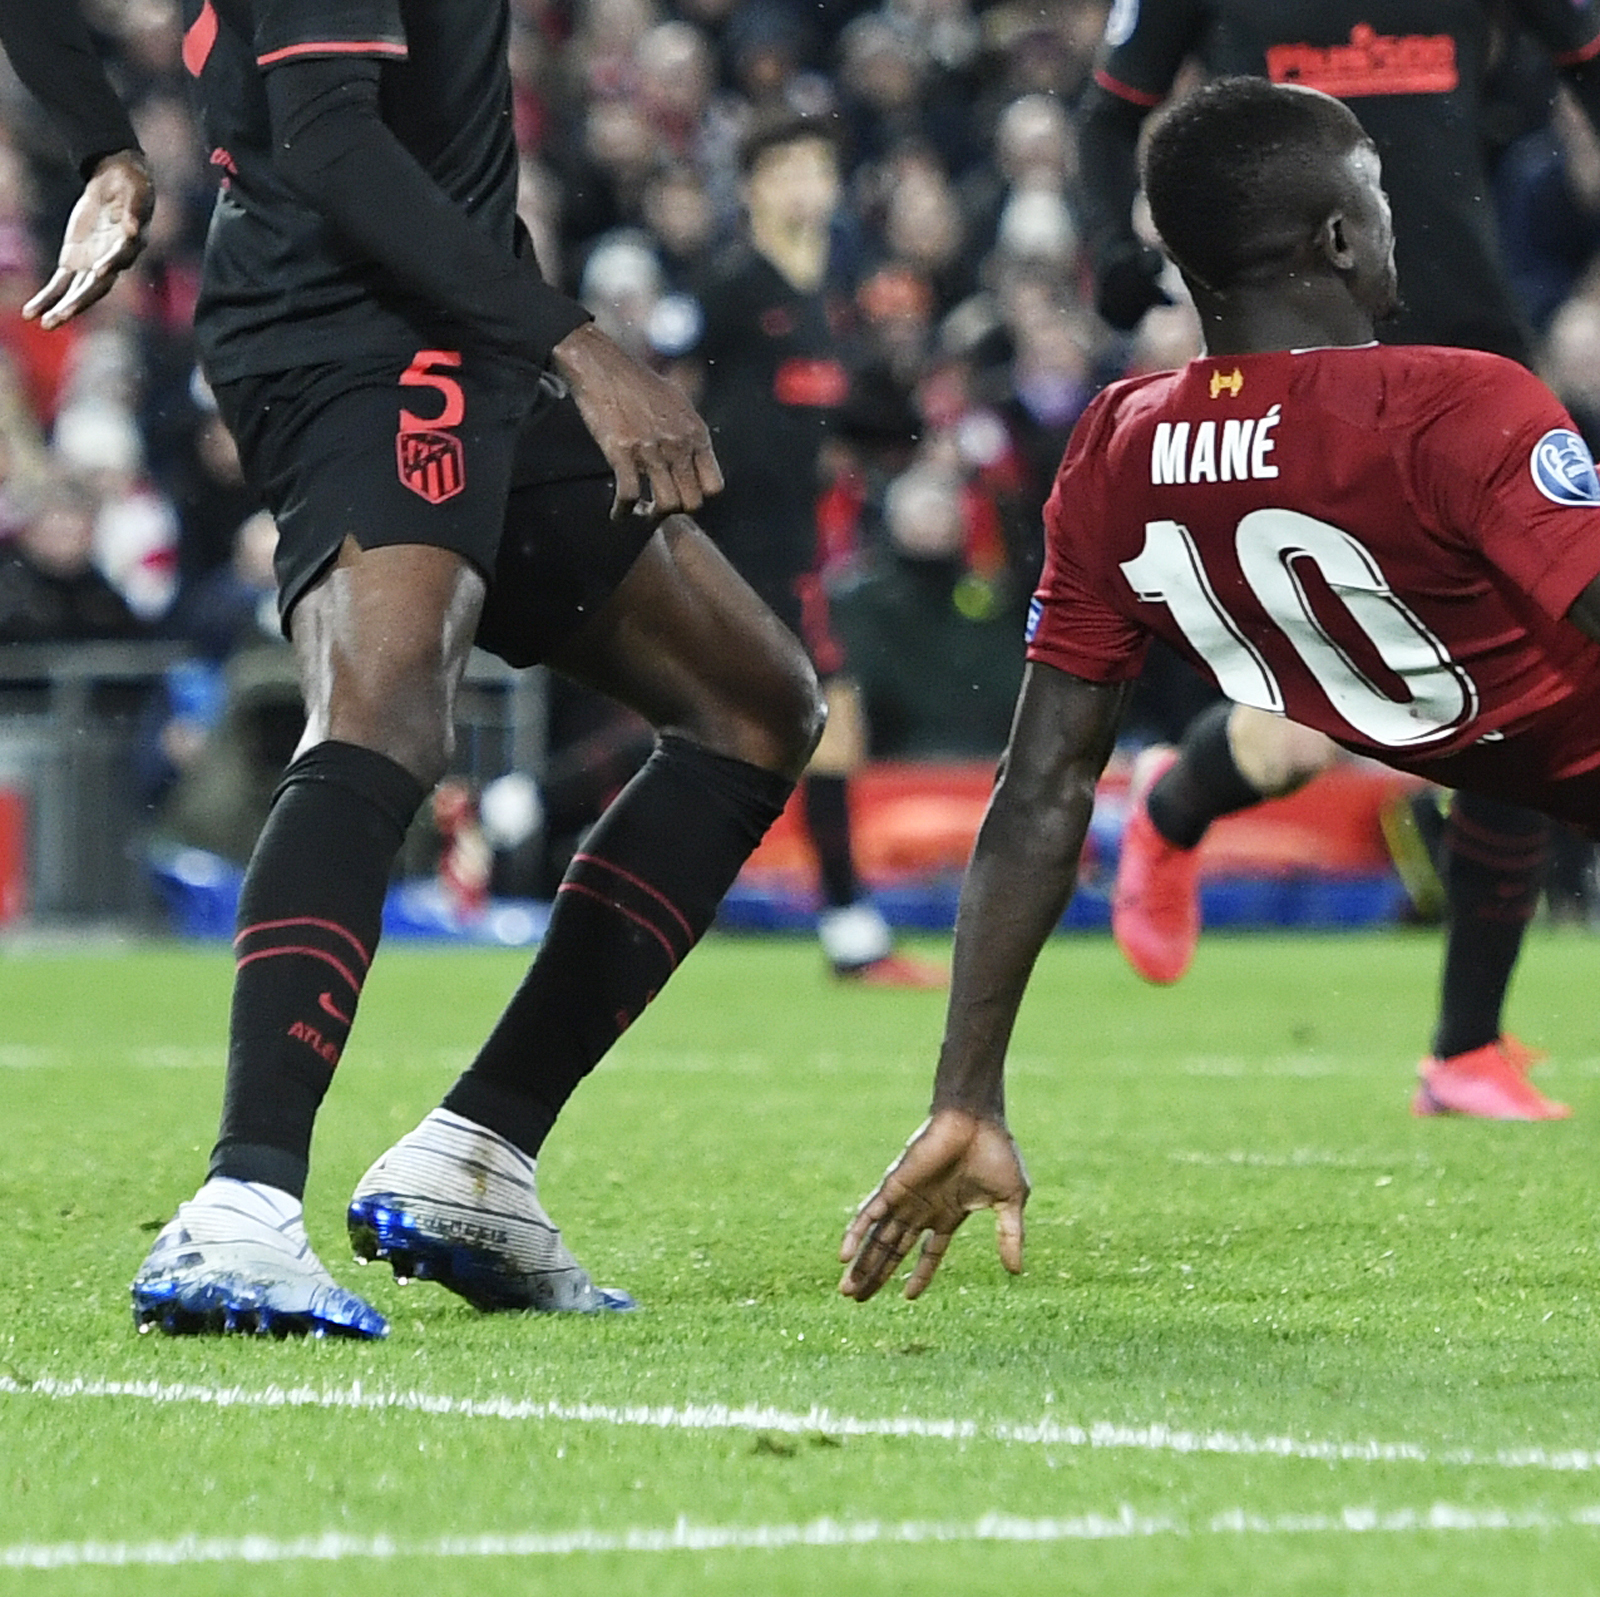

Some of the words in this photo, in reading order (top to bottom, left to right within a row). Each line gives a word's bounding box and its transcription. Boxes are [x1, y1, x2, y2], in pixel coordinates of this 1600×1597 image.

[399, 350, 465, 431] 5
[1151, 404, 1281, 485] MANÉ
[1120, 508, 1478, 746] 10
